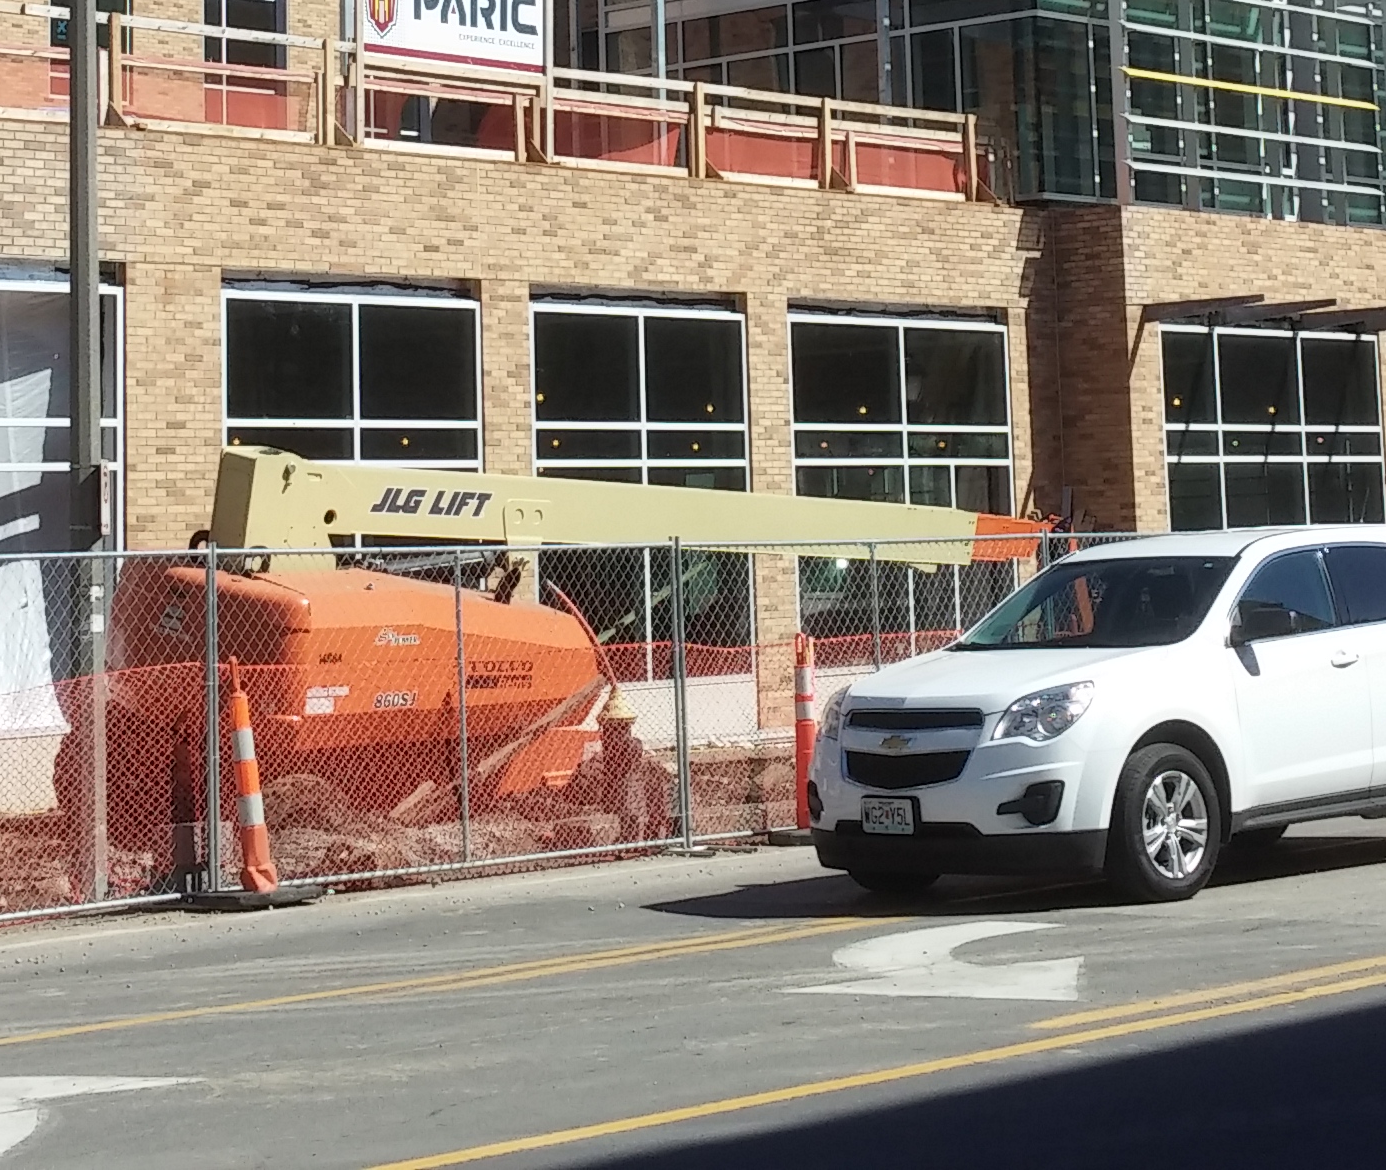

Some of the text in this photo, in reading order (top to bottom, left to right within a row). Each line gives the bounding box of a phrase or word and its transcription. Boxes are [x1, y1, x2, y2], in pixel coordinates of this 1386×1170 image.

[458, 33, 536, 50] EXPERIENCE EXCELLENCE
[369, 487, 494, 517] JLG LIFT
[373, 692, 417, 709] 860SJ
